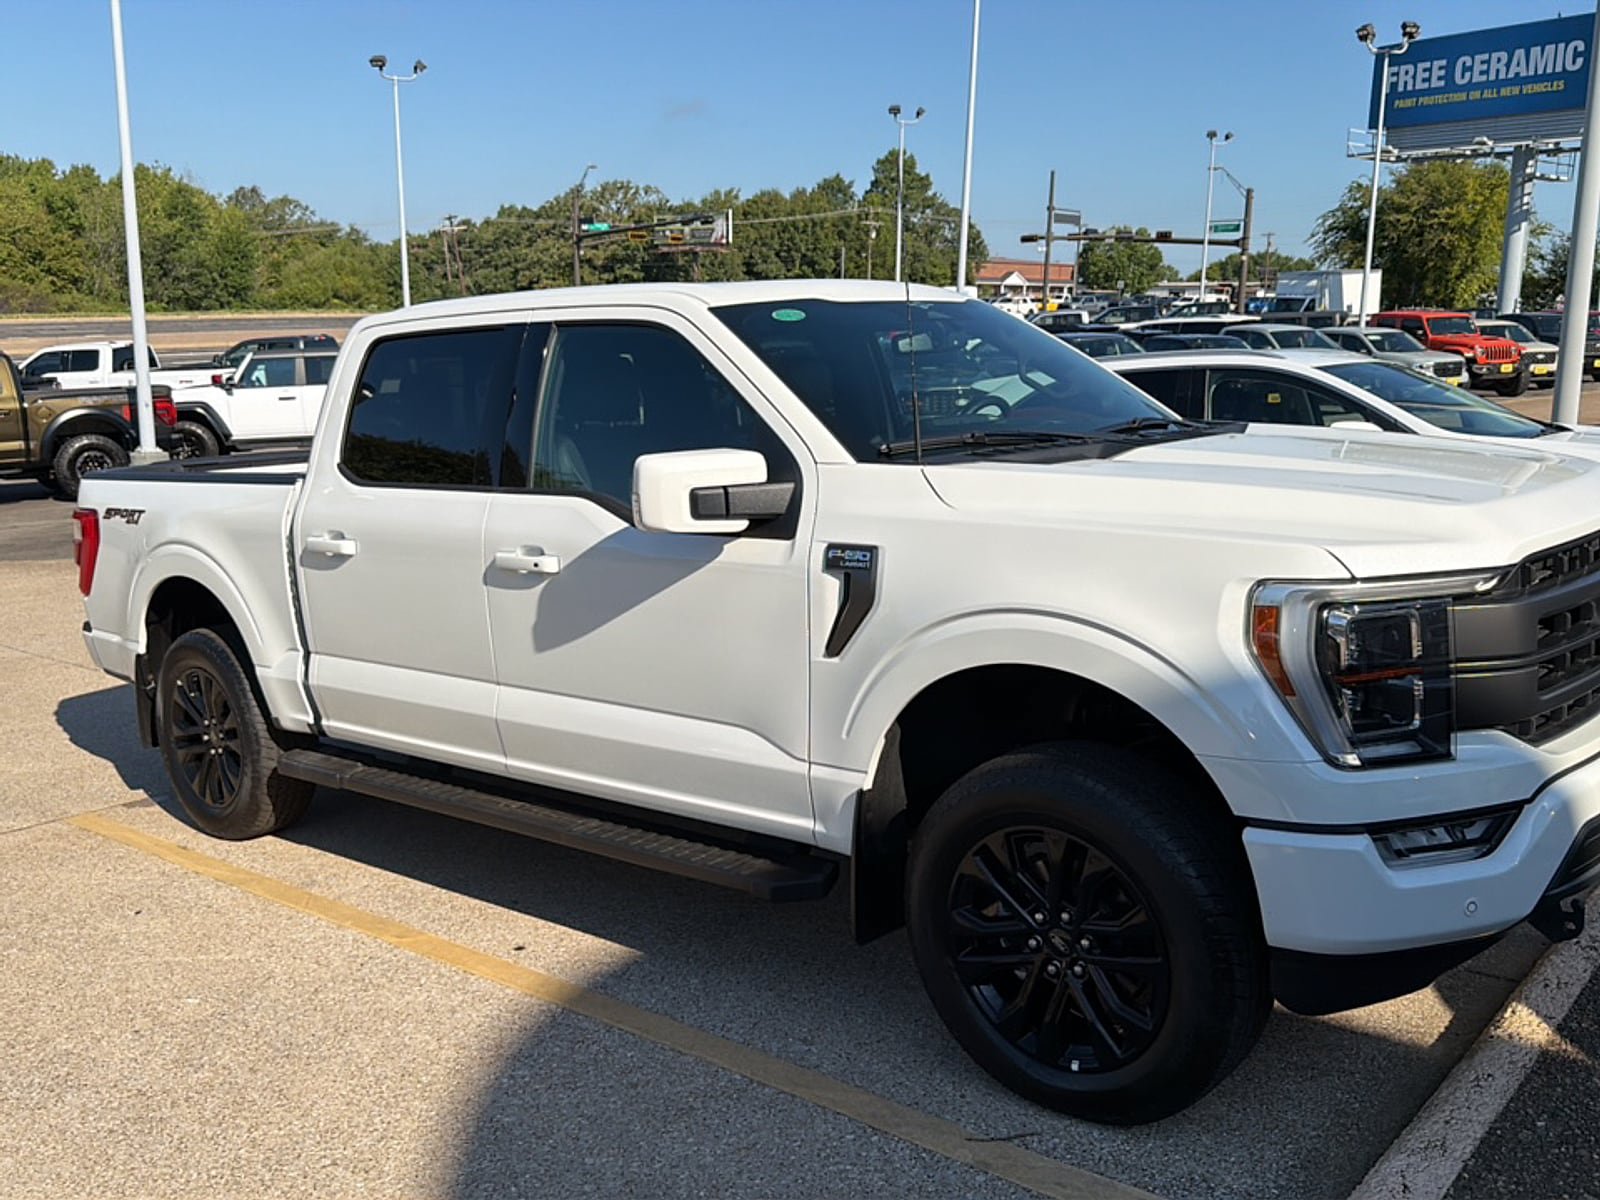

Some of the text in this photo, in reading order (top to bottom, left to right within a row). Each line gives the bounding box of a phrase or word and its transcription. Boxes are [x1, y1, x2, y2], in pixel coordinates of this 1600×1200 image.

[1387, 39, 1585, 94] FREE CERAMIC
[1393, 97, 1417, 109] PAINT
[1417, 91, 1468, 107] PROTECTION
[1482, 87, 1498, 99] ALL
[1500, 85, 1520, 97] NEW
[1522, 80, 1565, 95] VEHICLES
[103, 507, 146, 520] SPORT
